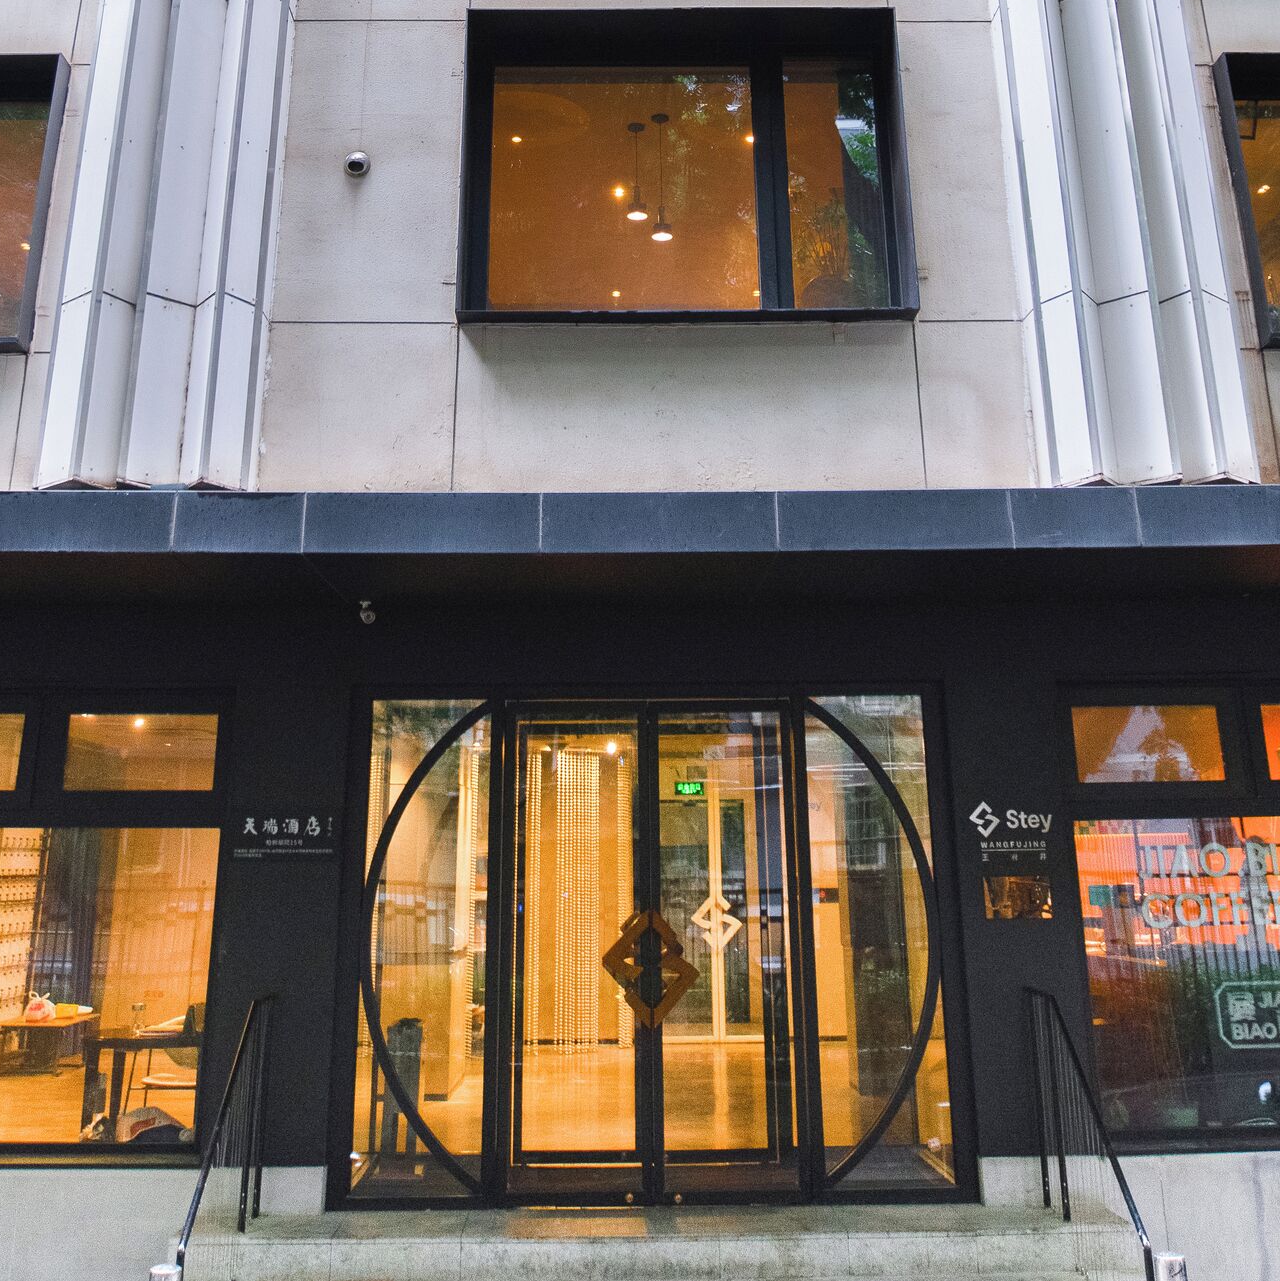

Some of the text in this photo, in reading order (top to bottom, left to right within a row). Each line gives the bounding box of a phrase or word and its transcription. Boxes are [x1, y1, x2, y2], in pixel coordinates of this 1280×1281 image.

[243, 815, 321, 837] 天瑞酒店
[1006, 809, 1052, 833] Stey
[980, 840, 1047, 849] WANGFUJING
[1139, 841, 1231, 879] JIAO
[1230, 1022, 1278, 1041] BIAO
